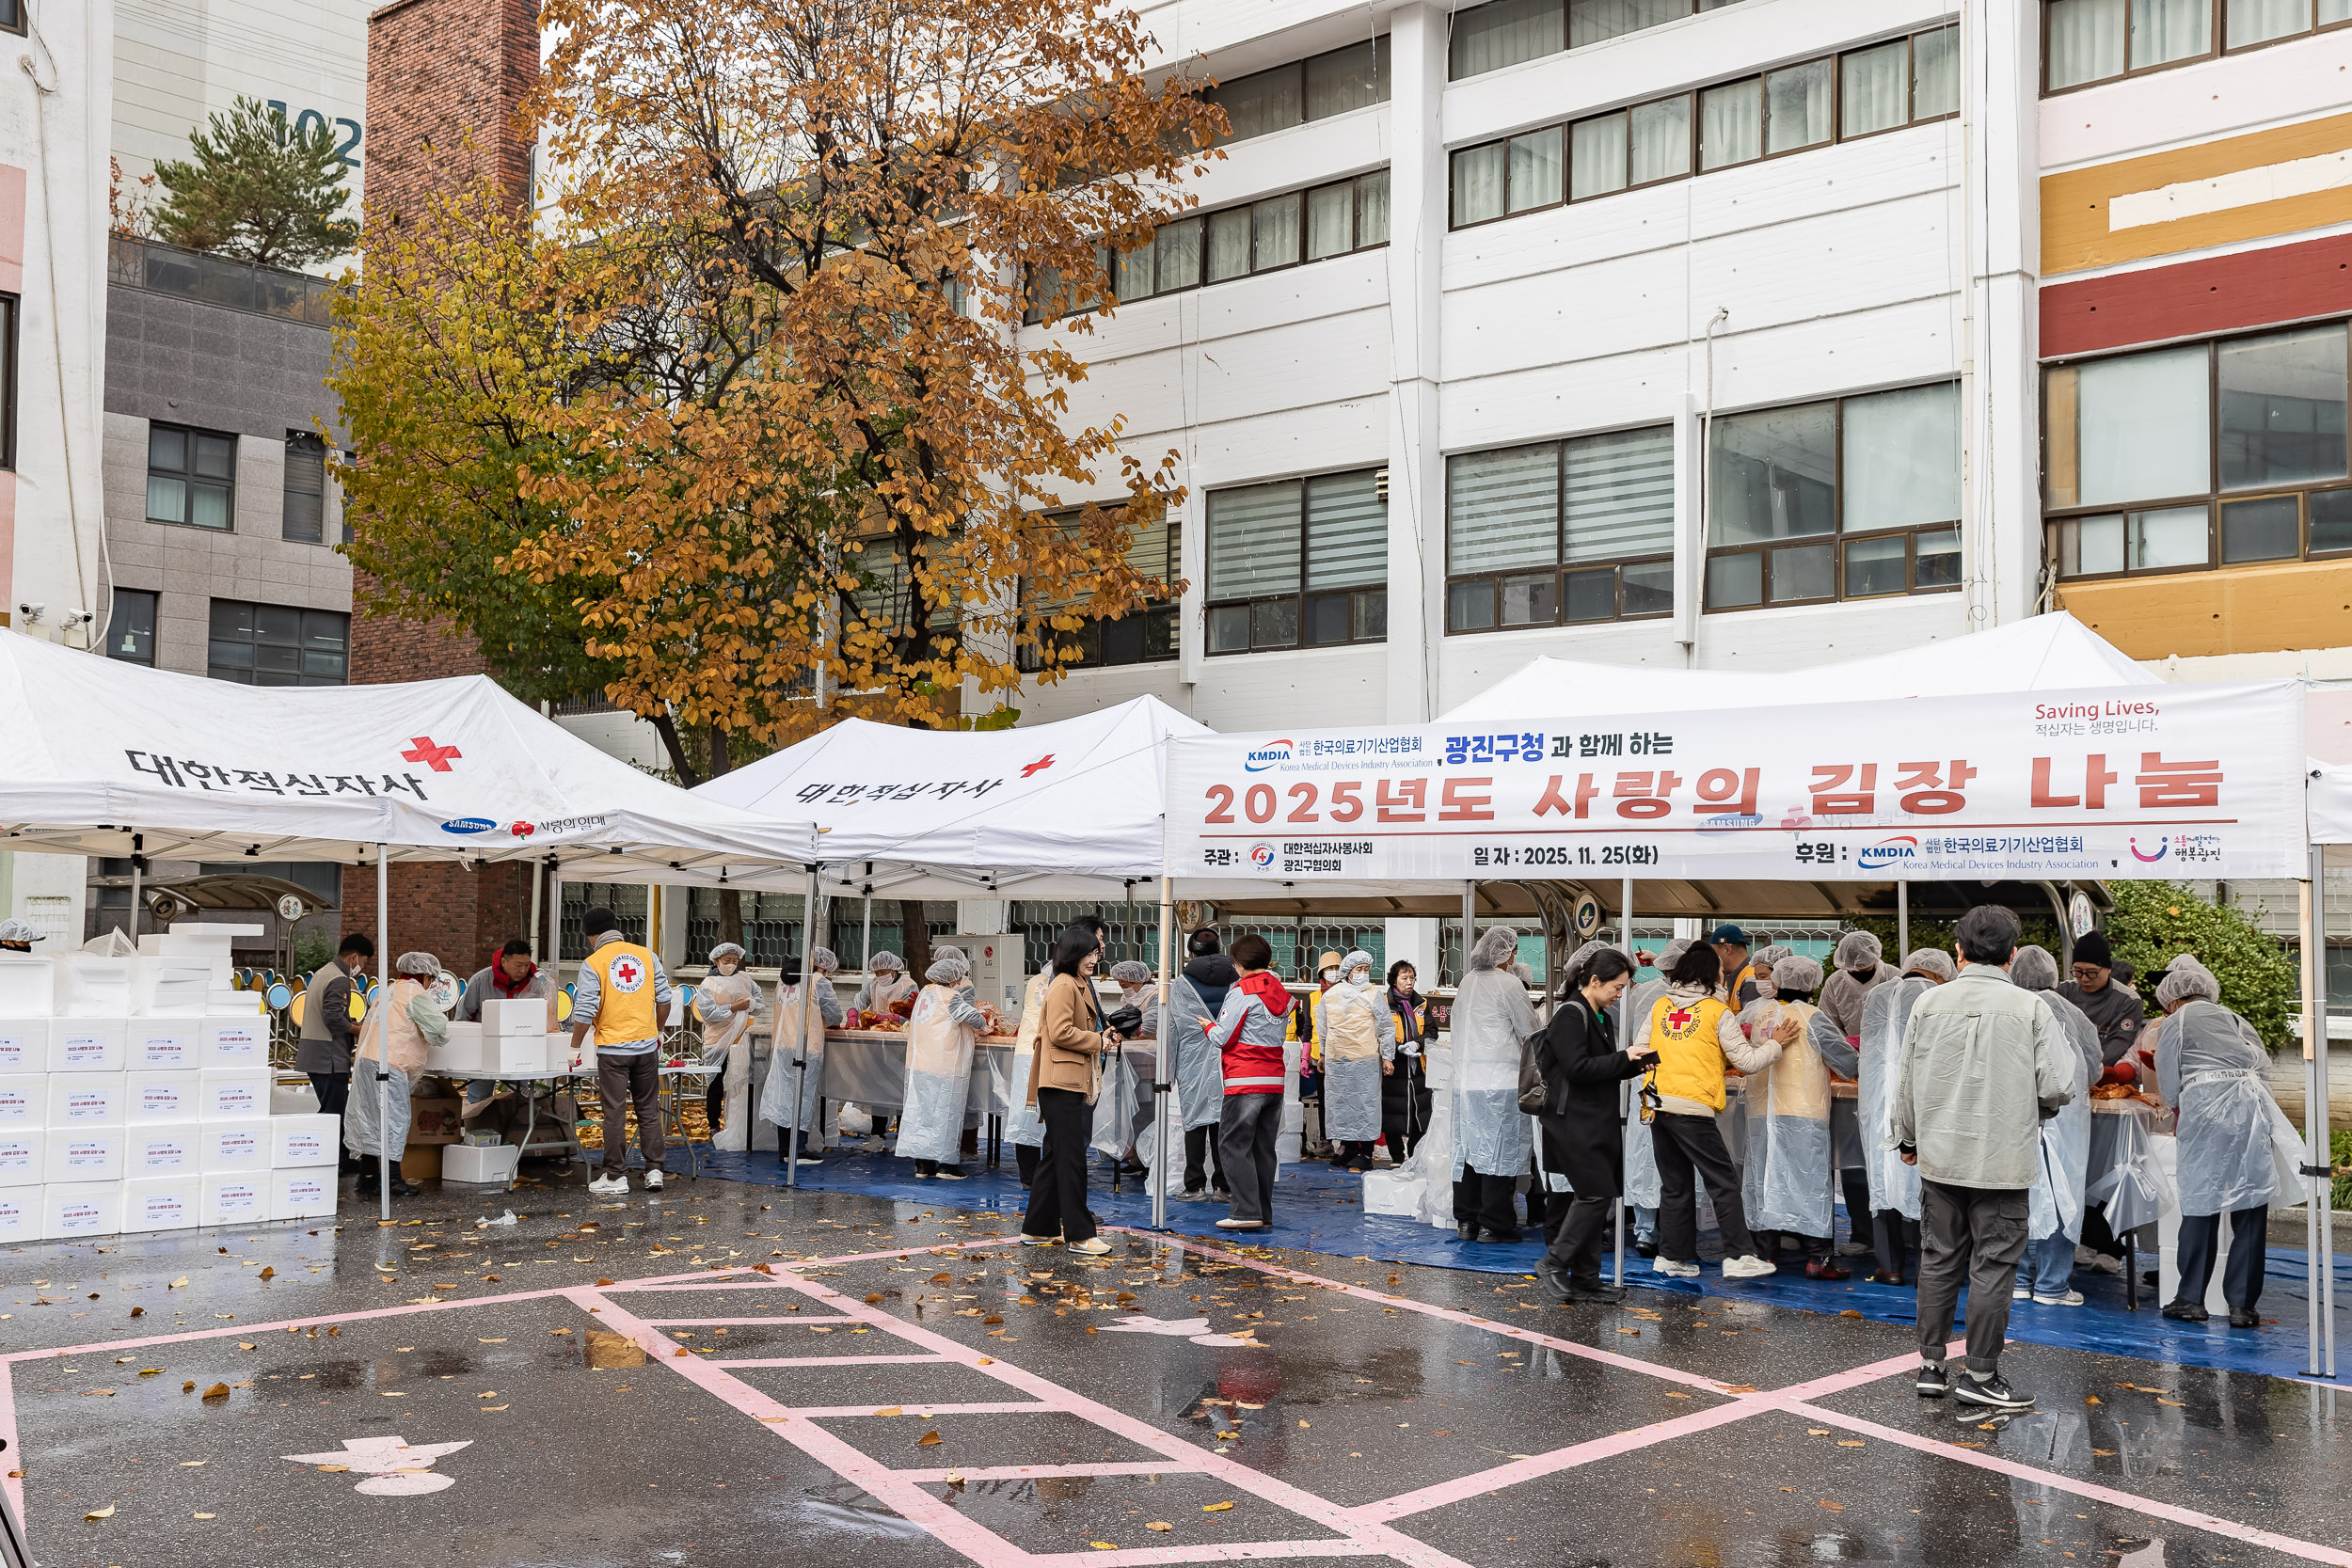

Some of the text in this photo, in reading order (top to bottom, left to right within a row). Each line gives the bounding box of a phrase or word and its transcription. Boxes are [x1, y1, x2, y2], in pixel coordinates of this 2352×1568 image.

[268, 100, 362, 167] 102
[2035, 700, 2159, 721] Saving Lives,
[2035, 719, 2158, 736] 적십자는 생명입니다.
[1313, 736, 1422, 756] 한국의료기기산업협회
[1445, 732, 1674, 764] 광진구청 과 함께 하는
[1248, 751, 1291, 761] KMDIA
[1279, 759, 1434, 772] Korea Medical Devices Industry Association
[1205, 752, 2224, 824] 2025년도 사랑의 김장 나눔
[1283, 842, 1373, 855] 대한적십자사봉사회
[1862, 847, 1915, 858] KMDIA
[1926, 846, 1942, 854] 법인
[1944, 835, 2083, 854] 한국의료기기산업협회
[1601, 845, 1659, 865] 25(화)
[2175, 847, 2220, 863] 행복광진
[1283, 859, 1342, 872] 광진구협의회
[1903, 859, 2099, 871] Korea Medical Devices Industry Association
[1671, 1032, 1682, 1041] RED
[1683, 1018, 1701, 1038] CROSS
